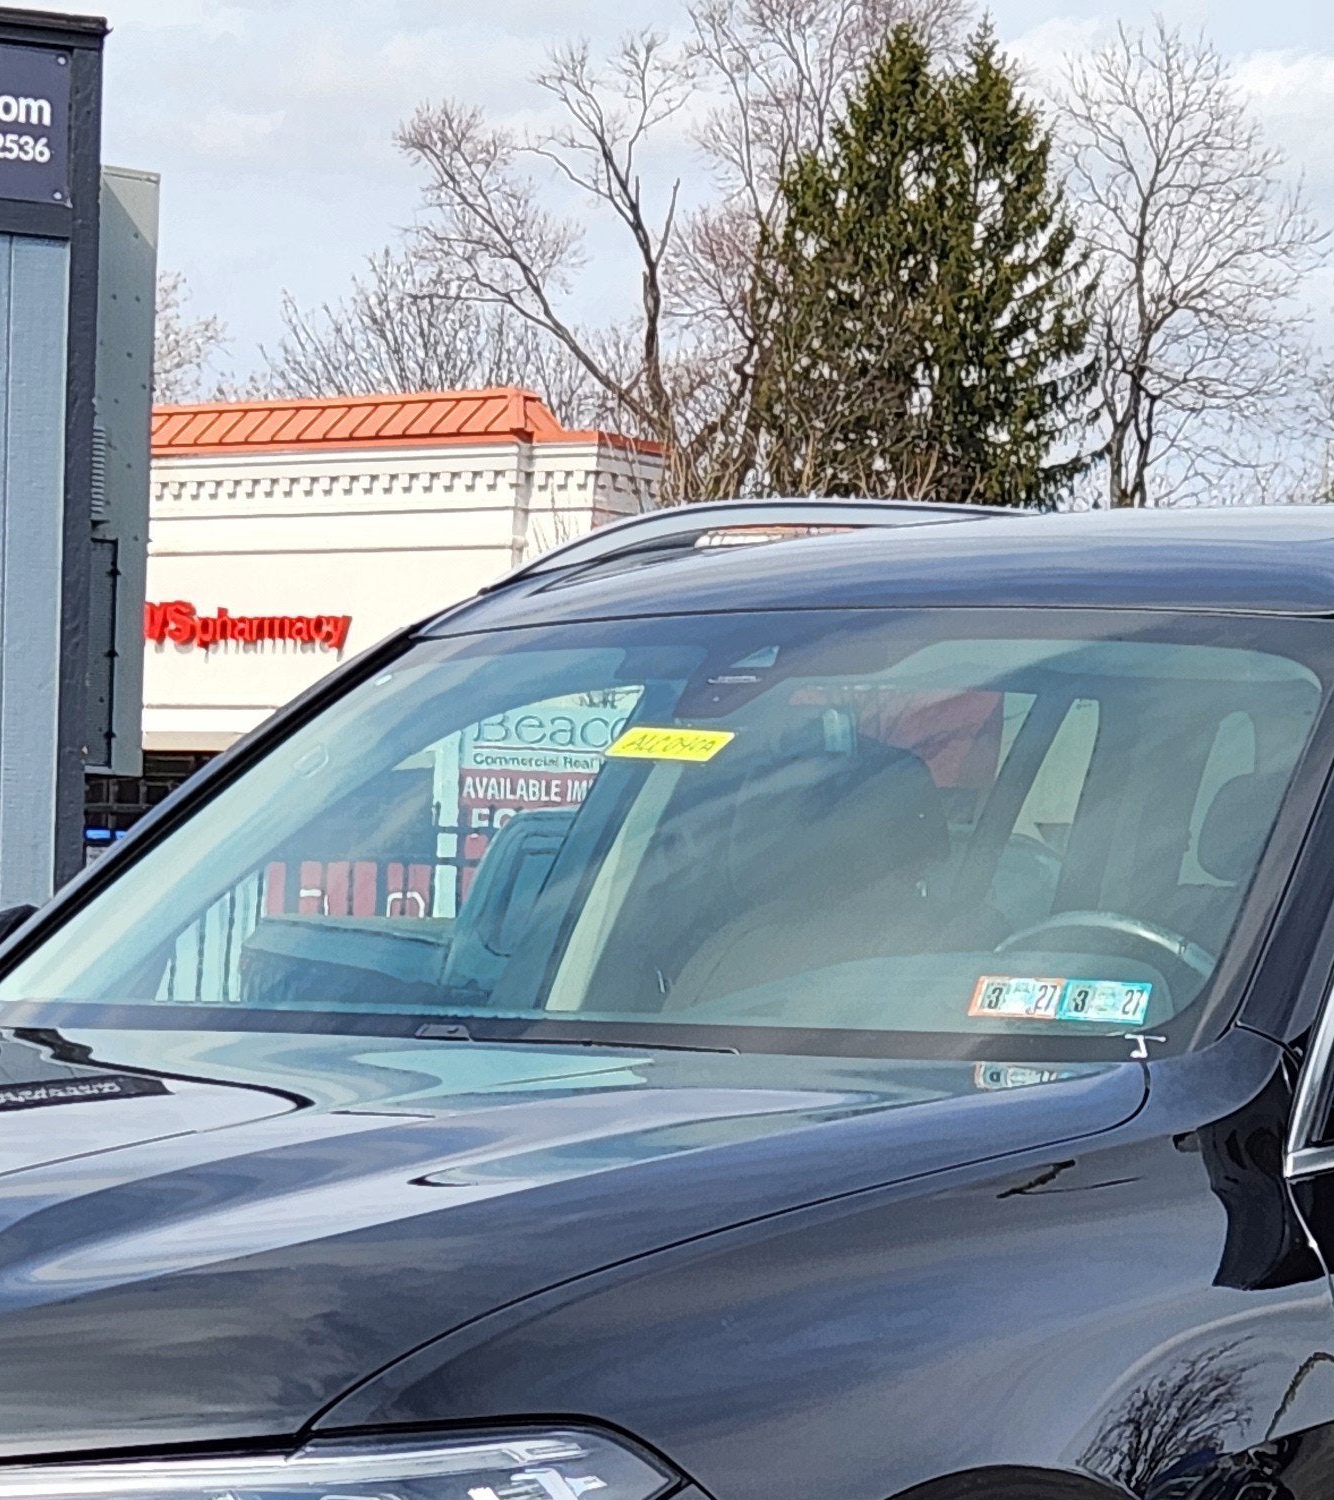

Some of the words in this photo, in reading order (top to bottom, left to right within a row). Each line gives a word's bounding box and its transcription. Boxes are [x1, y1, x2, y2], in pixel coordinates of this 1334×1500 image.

[462, 777, 562, 803] AVAILABLE
[986, 986, 1004, 1010] 3
[1035, 985, 1058, 1012] 27
[1073, 989, 1090, 1013] 3
[1121, 989, 1145, 1015] 27
